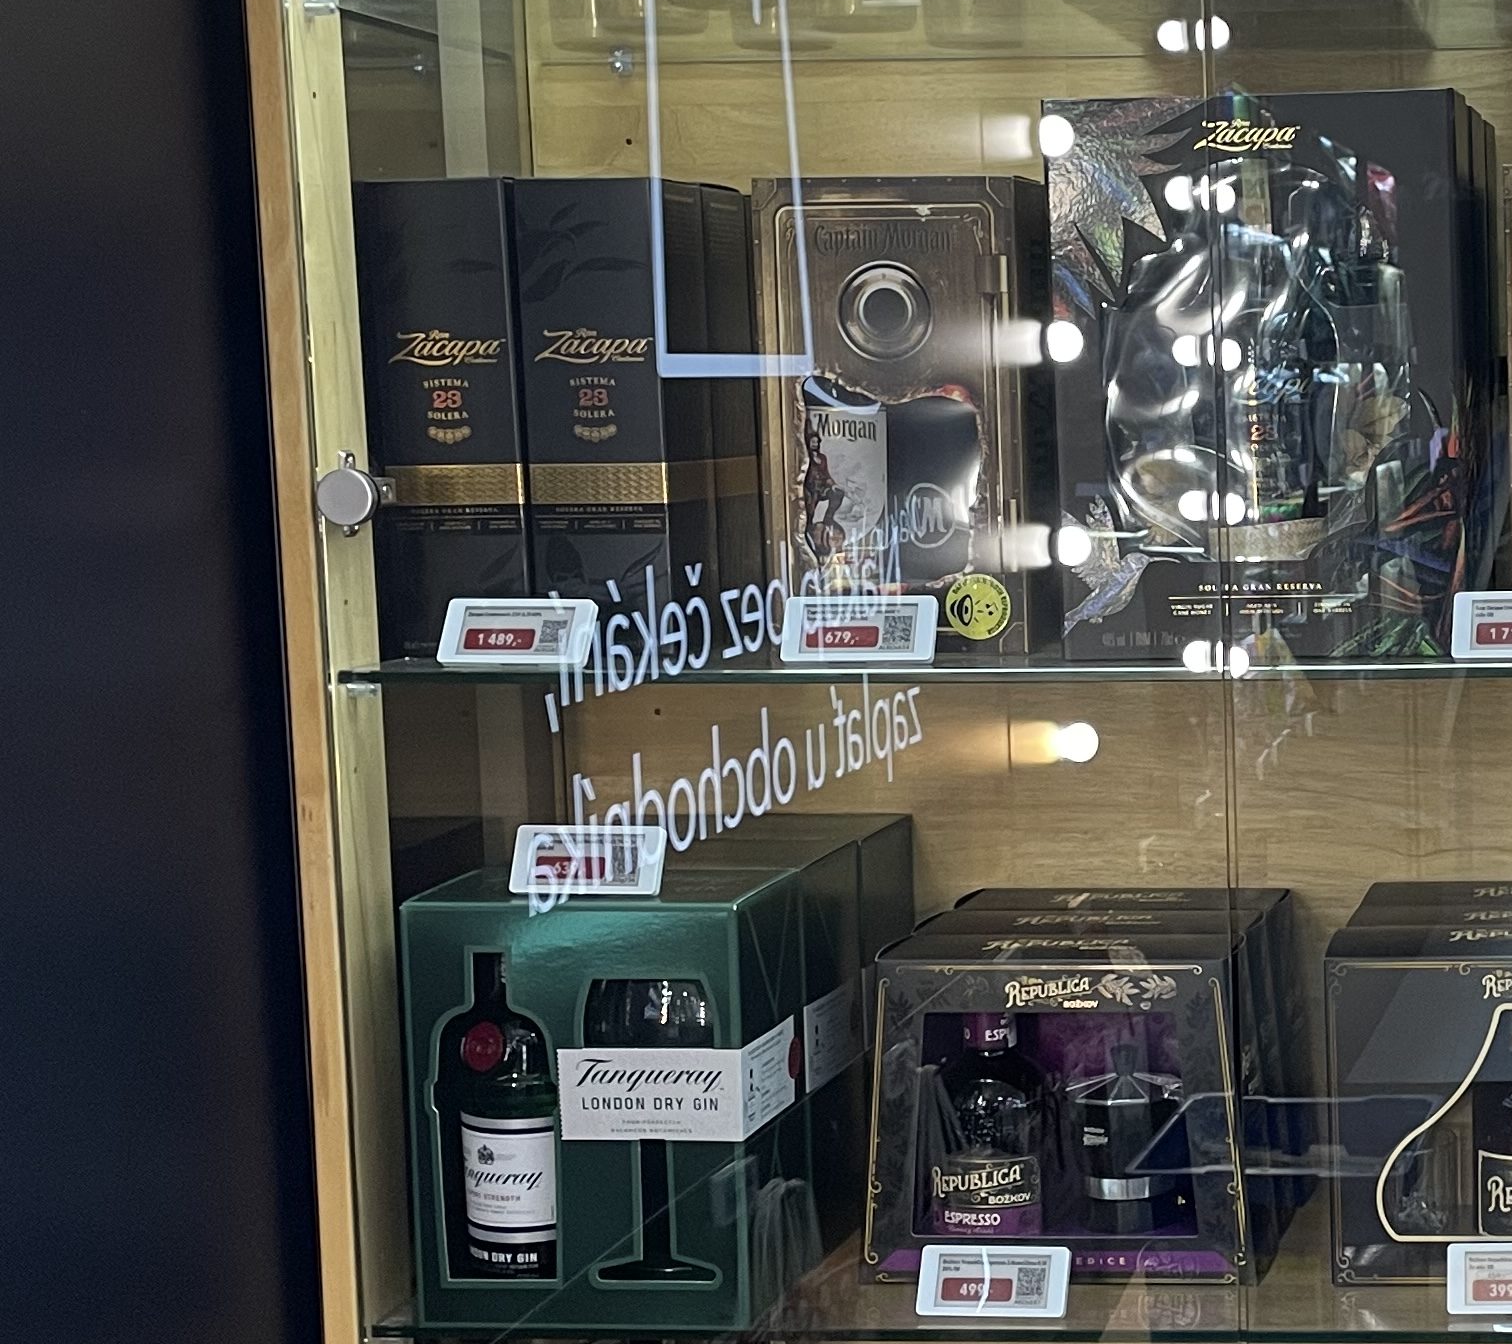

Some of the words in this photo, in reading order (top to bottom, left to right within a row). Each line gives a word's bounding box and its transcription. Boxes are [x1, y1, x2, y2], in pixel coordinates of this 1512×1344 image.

[432, 391, 462, 408] 23
[578, 388, 609, 406] 23
[816, 413, 877, 442] Morgan
[1276, 583, 1322, 591] RESERVA
[488, 634, 522, 646] 489,-
[825, 631, 860, 645] 679,-
[1005, 977, 1090, 1008] REPUBLICA
[575, 1058, 724, 1092] Tanqueray
[581, 1097, 646, 1111] LONDON
[653, 1097, 684, 1111] DRY
[693, 1097, 719, 1111] GIN
[932, 1164, 1021, 1198] REPUBLICA
[944, 1211, 1000, 1226] ESPRESSO
[492, 1252, 512, 1263] DRY
[517, 1253, 538, 1263] GIN
